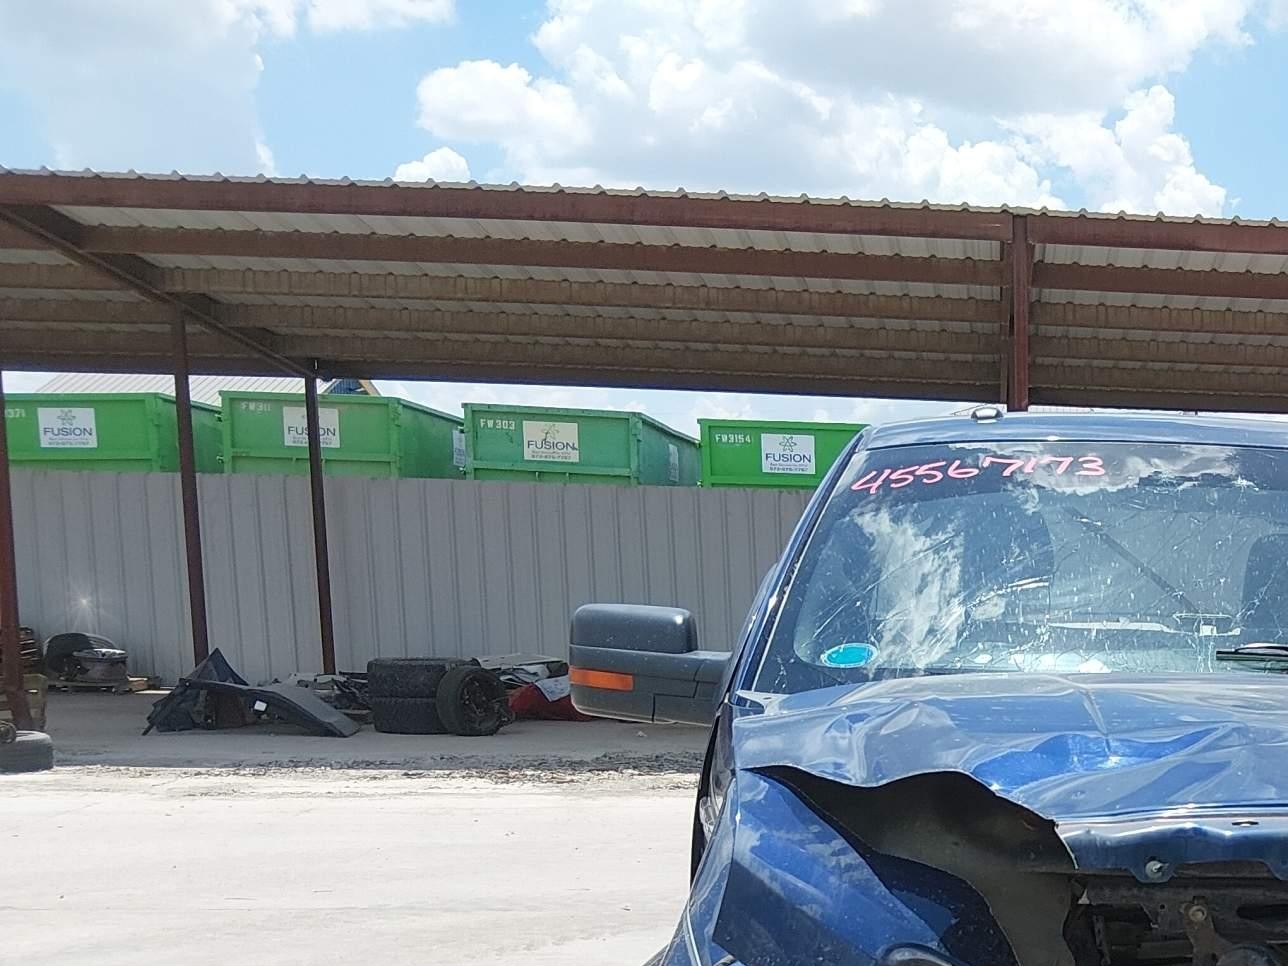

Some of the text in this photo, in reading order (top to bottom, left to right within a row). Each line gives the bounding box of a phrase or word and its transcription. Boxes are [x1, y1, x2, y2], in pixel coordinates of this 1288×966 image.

[43, 427, 93, 437] FUSION
[287, 426, 336, 436] FUON
[527, 440, 576, 451] FUSION
[765, 453, 811, 463] FUSION
[851, 455, 1106, 495] 45567173
